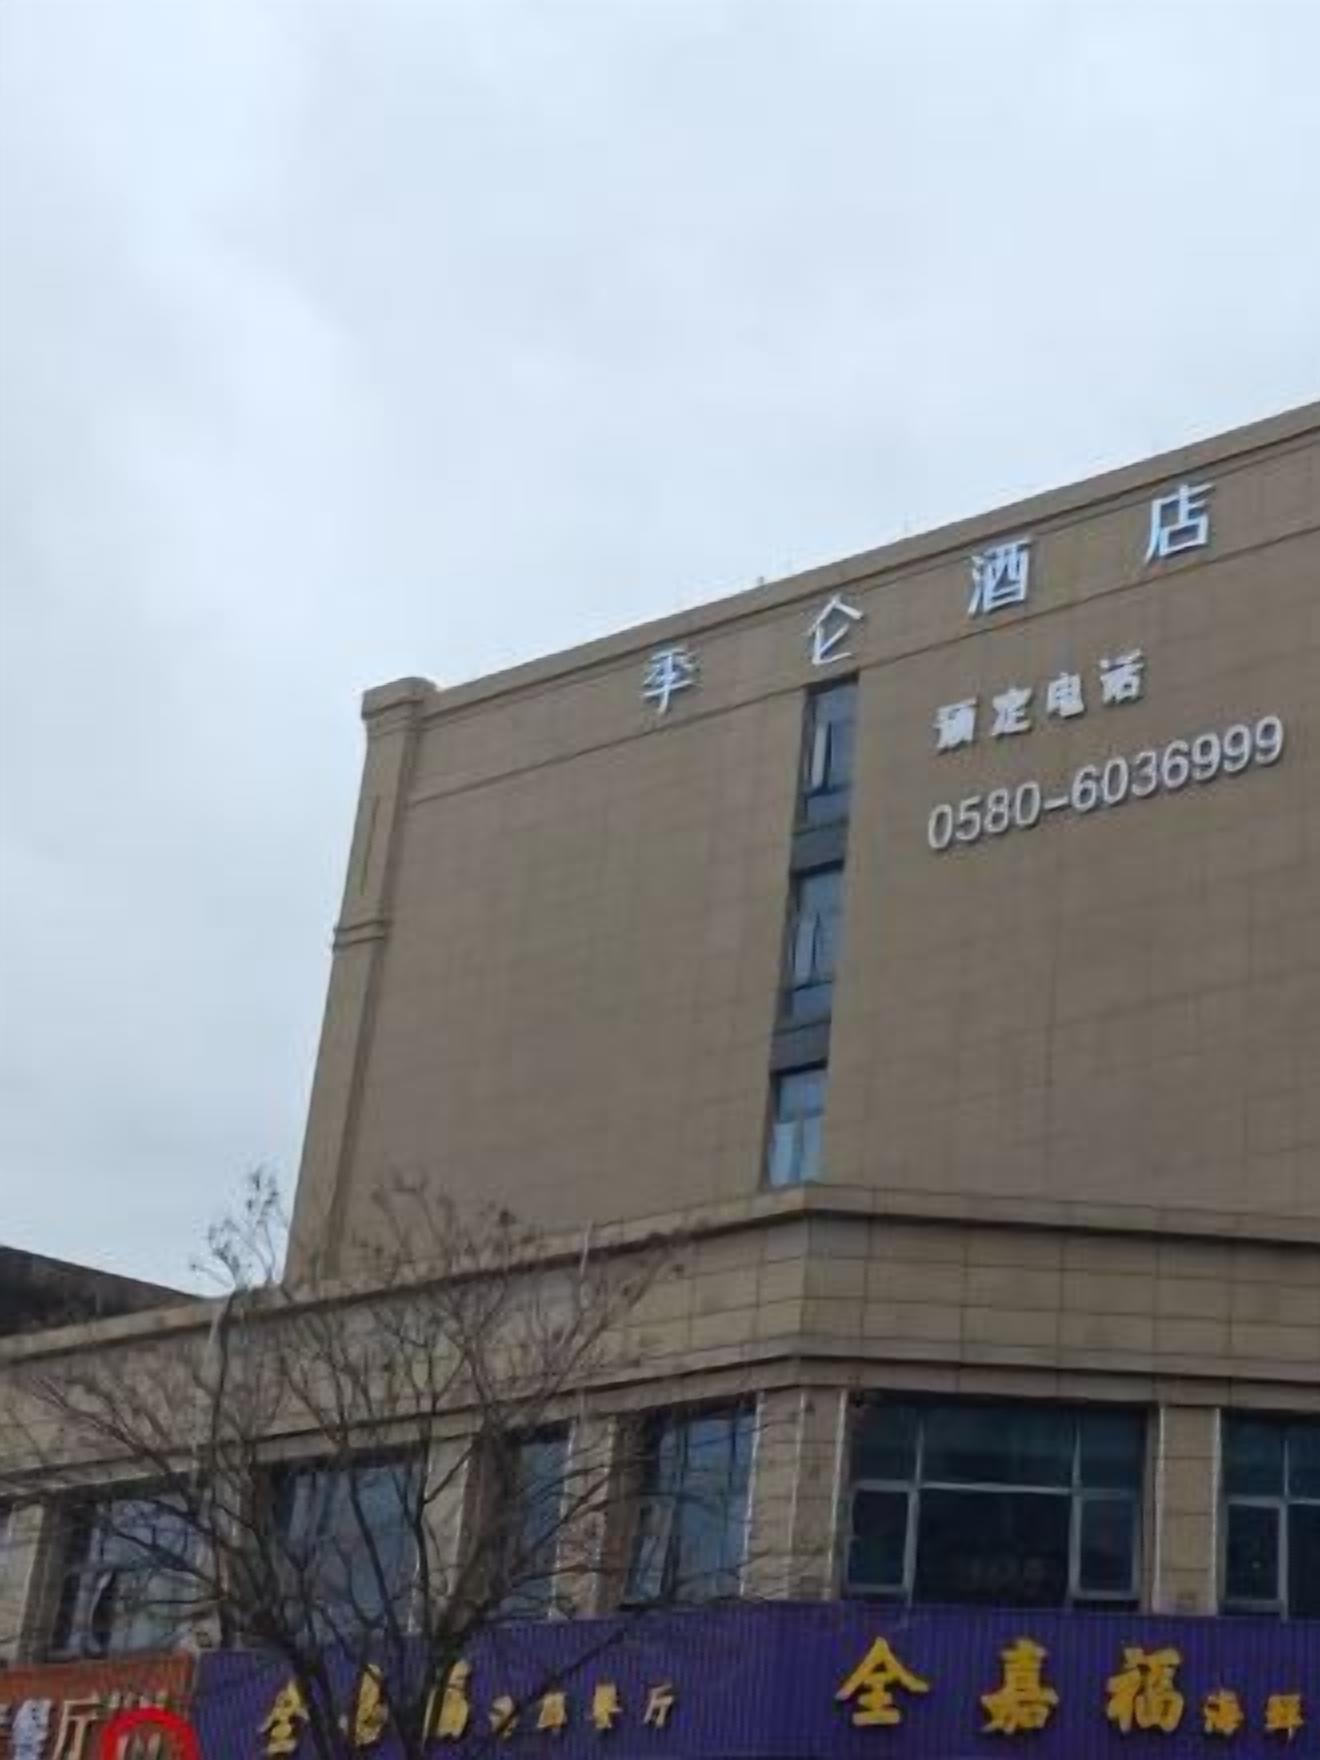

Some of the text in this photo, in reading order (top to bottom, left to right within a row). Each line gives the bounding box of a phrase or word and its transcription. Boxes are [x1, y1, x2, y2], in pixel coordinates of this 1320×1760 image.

[643, 482, 1216, 716] 季仑酒店
[928, 714, 1285, 851] 0580-6036999
